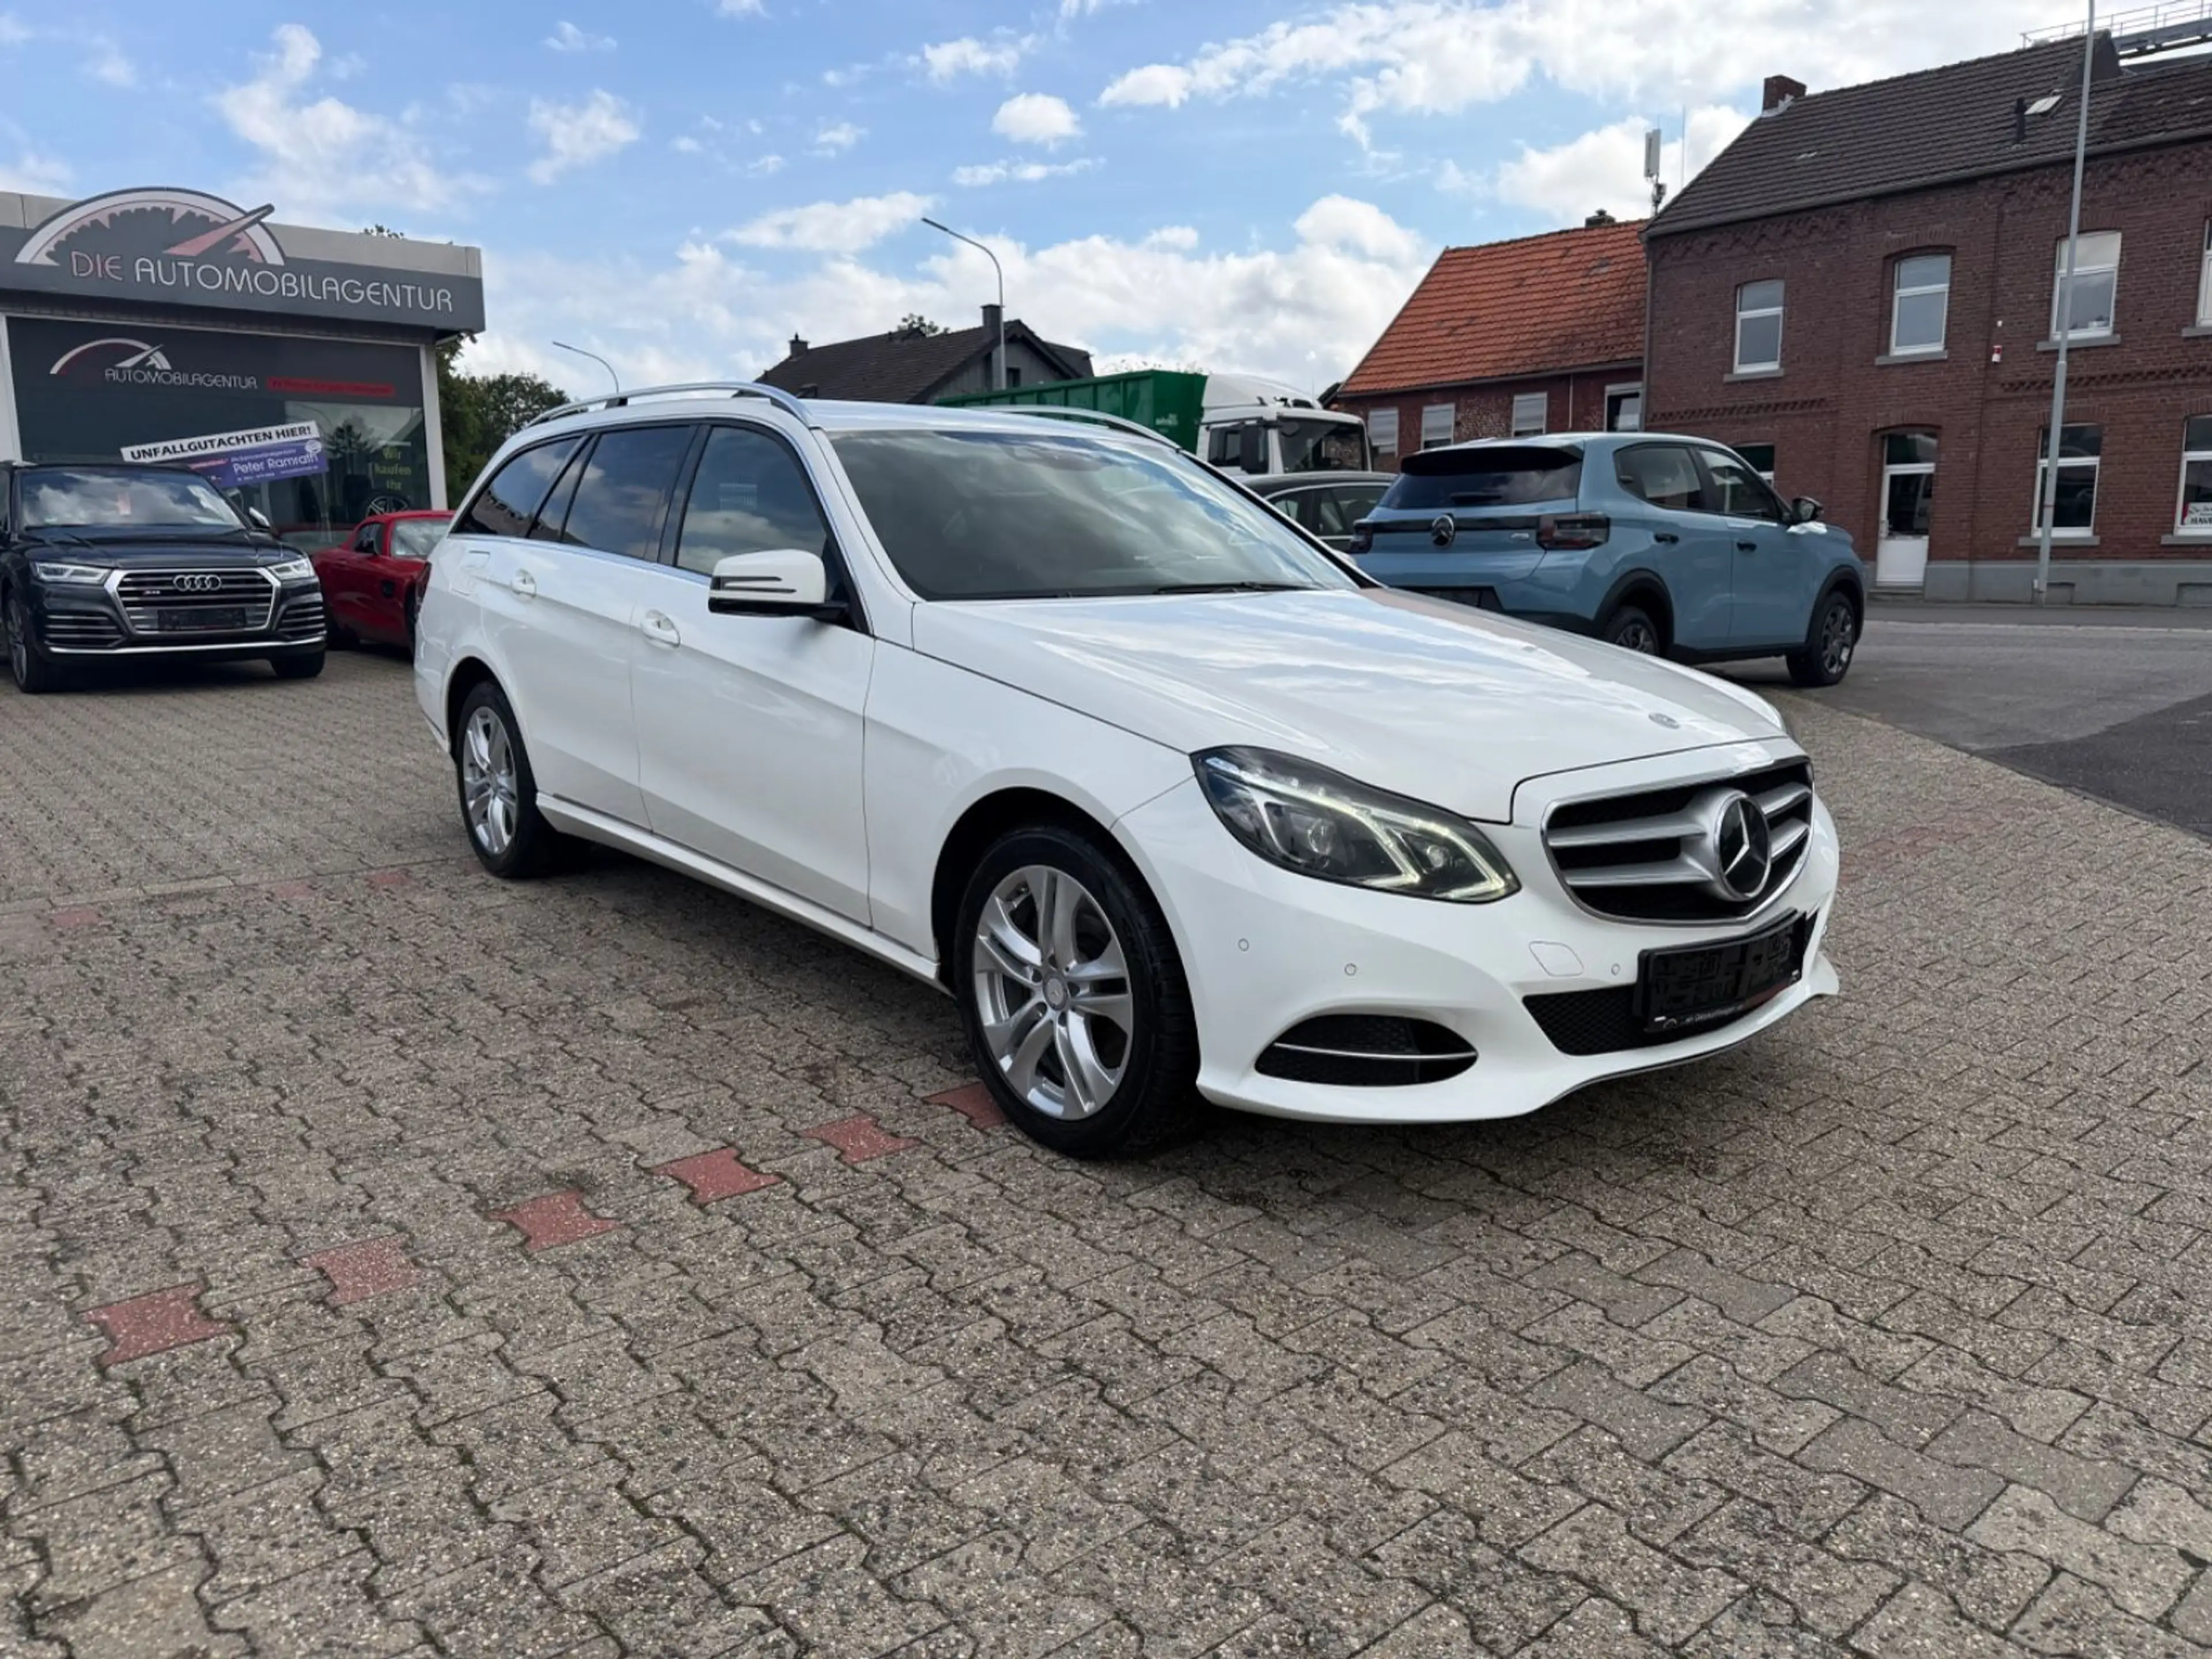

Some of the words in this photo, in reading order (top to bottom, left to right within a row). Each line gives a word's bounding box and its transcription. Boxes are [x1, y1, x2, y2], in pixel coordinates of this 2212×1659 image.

[71, 250, 123, 282] DIE
[135, 257, 453, 312] AUTOMOBILAGENTUR
[104, 368, 258, 389] AUTOMOBILAGENTUR
[130, 431, 272, 460] UNFALLGUTACHTEN
[275, 426, 311, 439] HIER!
[233, 461, 264, 475] Peter
